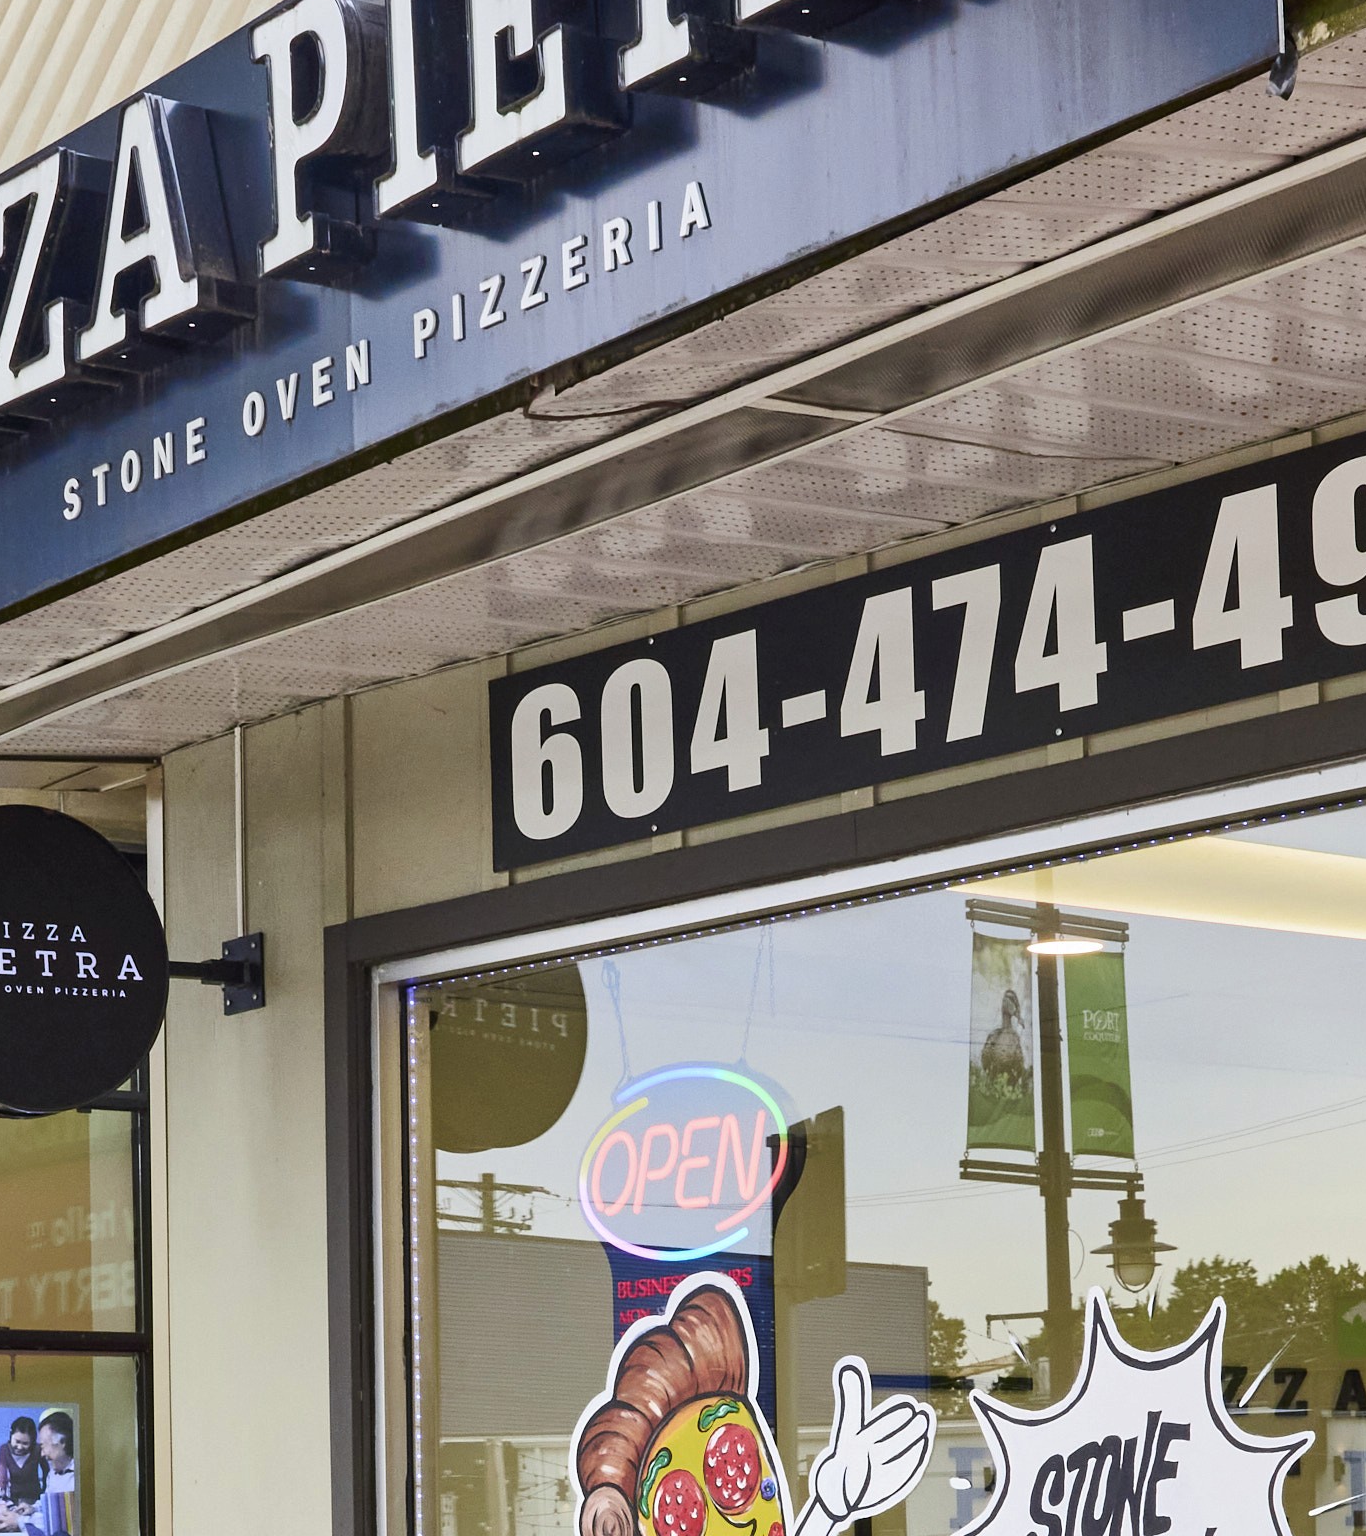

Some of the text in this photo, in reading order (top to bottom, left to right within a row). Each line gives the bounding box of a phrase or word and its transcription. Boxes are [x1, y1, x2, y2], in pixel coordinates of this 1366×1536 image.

[63, 181, 713, 520] STONE OVEN PIZZERIA
[4, 985, 44, 995] OVEN
[55, 987, 128, 998] PIZZERIA
[590, 1110, 769, 1220] OPEN
